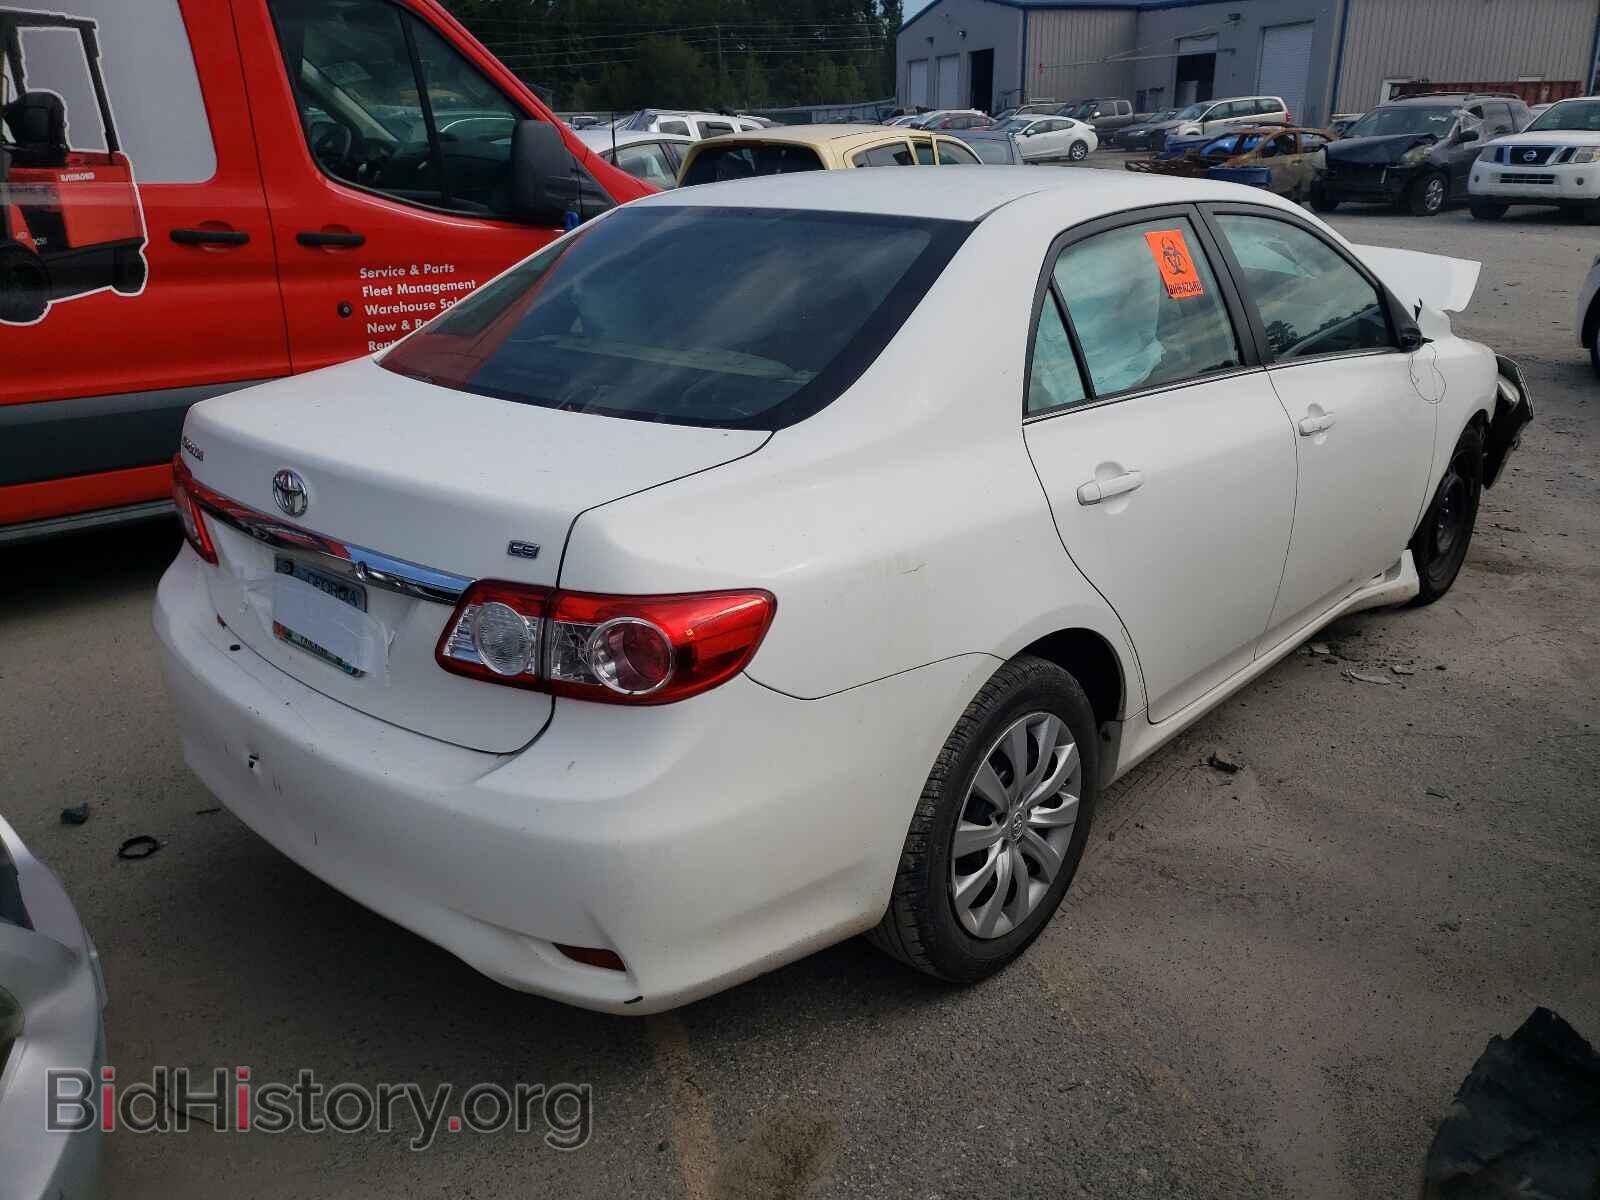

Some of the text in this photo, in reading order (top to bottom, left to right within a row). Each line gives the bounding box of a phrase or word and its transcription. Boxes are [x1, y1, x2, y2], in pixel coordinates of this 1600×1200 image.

[360, 263, 454, 278] Service & Parts
[362, 280, 476, 297] Fleet Management
[365, 301, 436, 315] Warehouse
[367, 322, 397, 333] New
[401, 320, 410, 330] &
